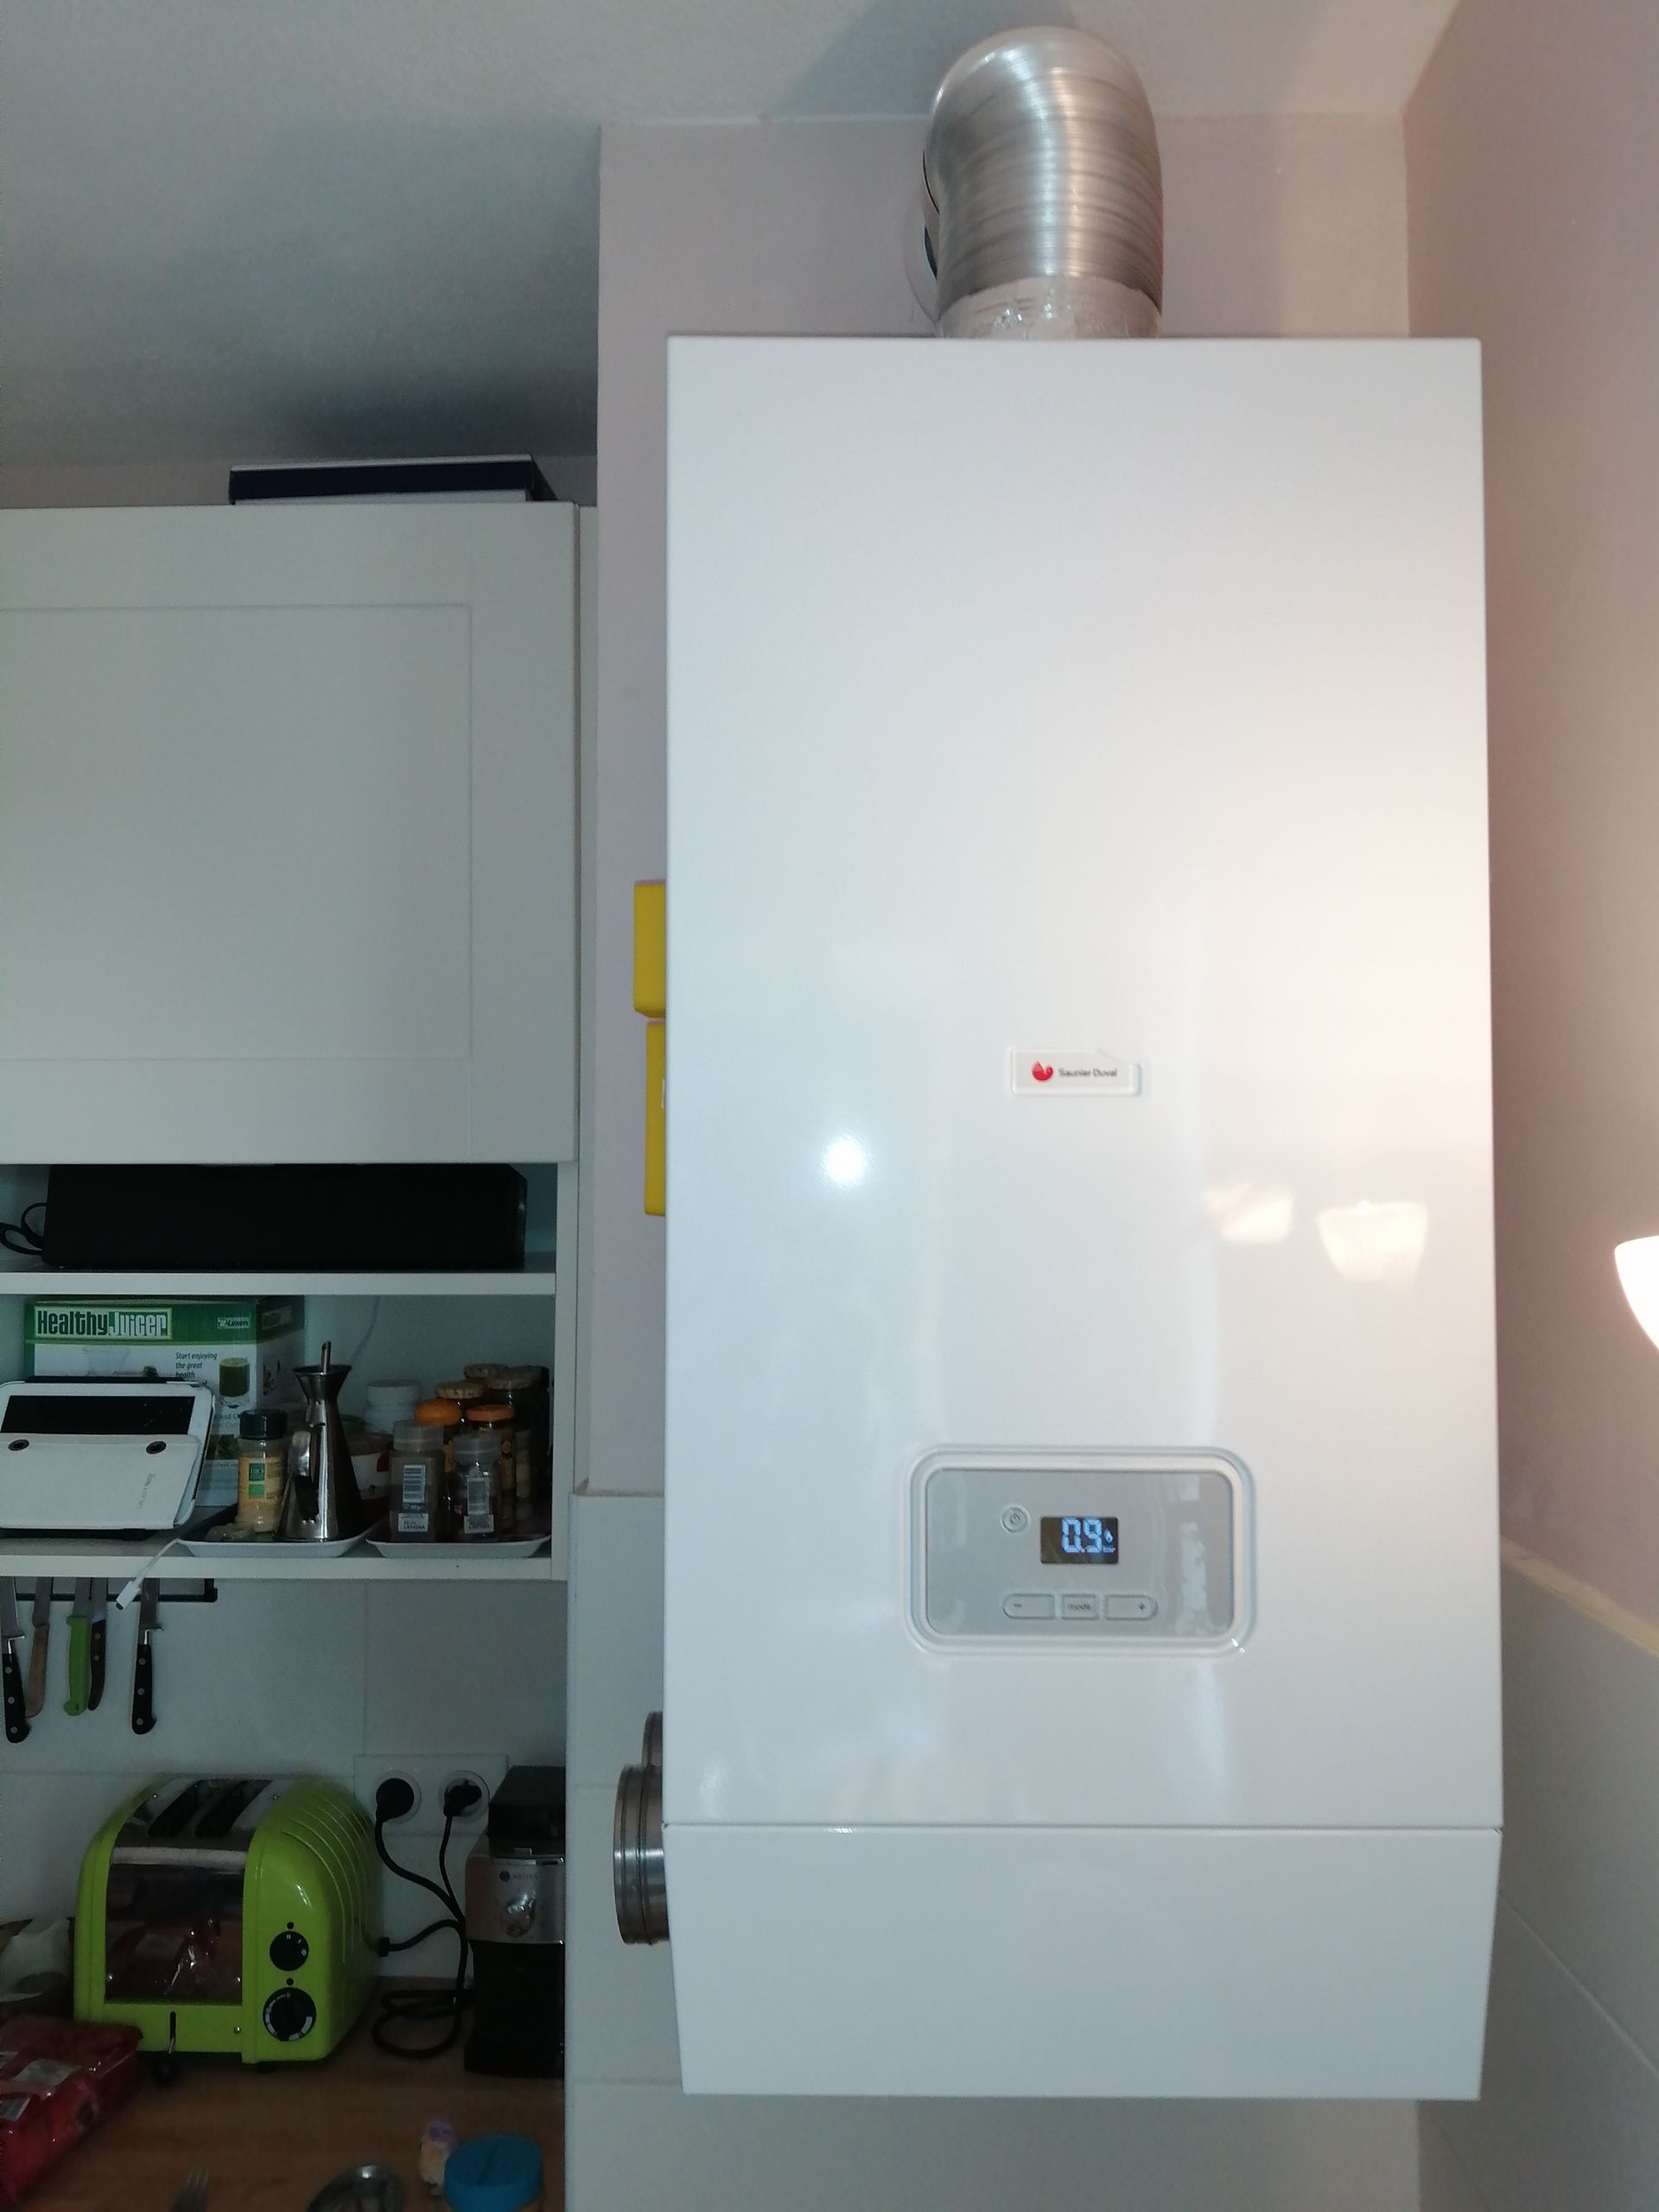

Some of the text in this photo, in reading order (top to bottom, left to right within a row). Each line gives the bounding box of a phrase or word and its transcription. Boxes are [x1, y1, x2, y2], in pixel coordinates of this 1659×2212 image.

[1058, 1068, 1117, 1077] Saunier Duval
[192, 1352, 217, 1361] enjoying
